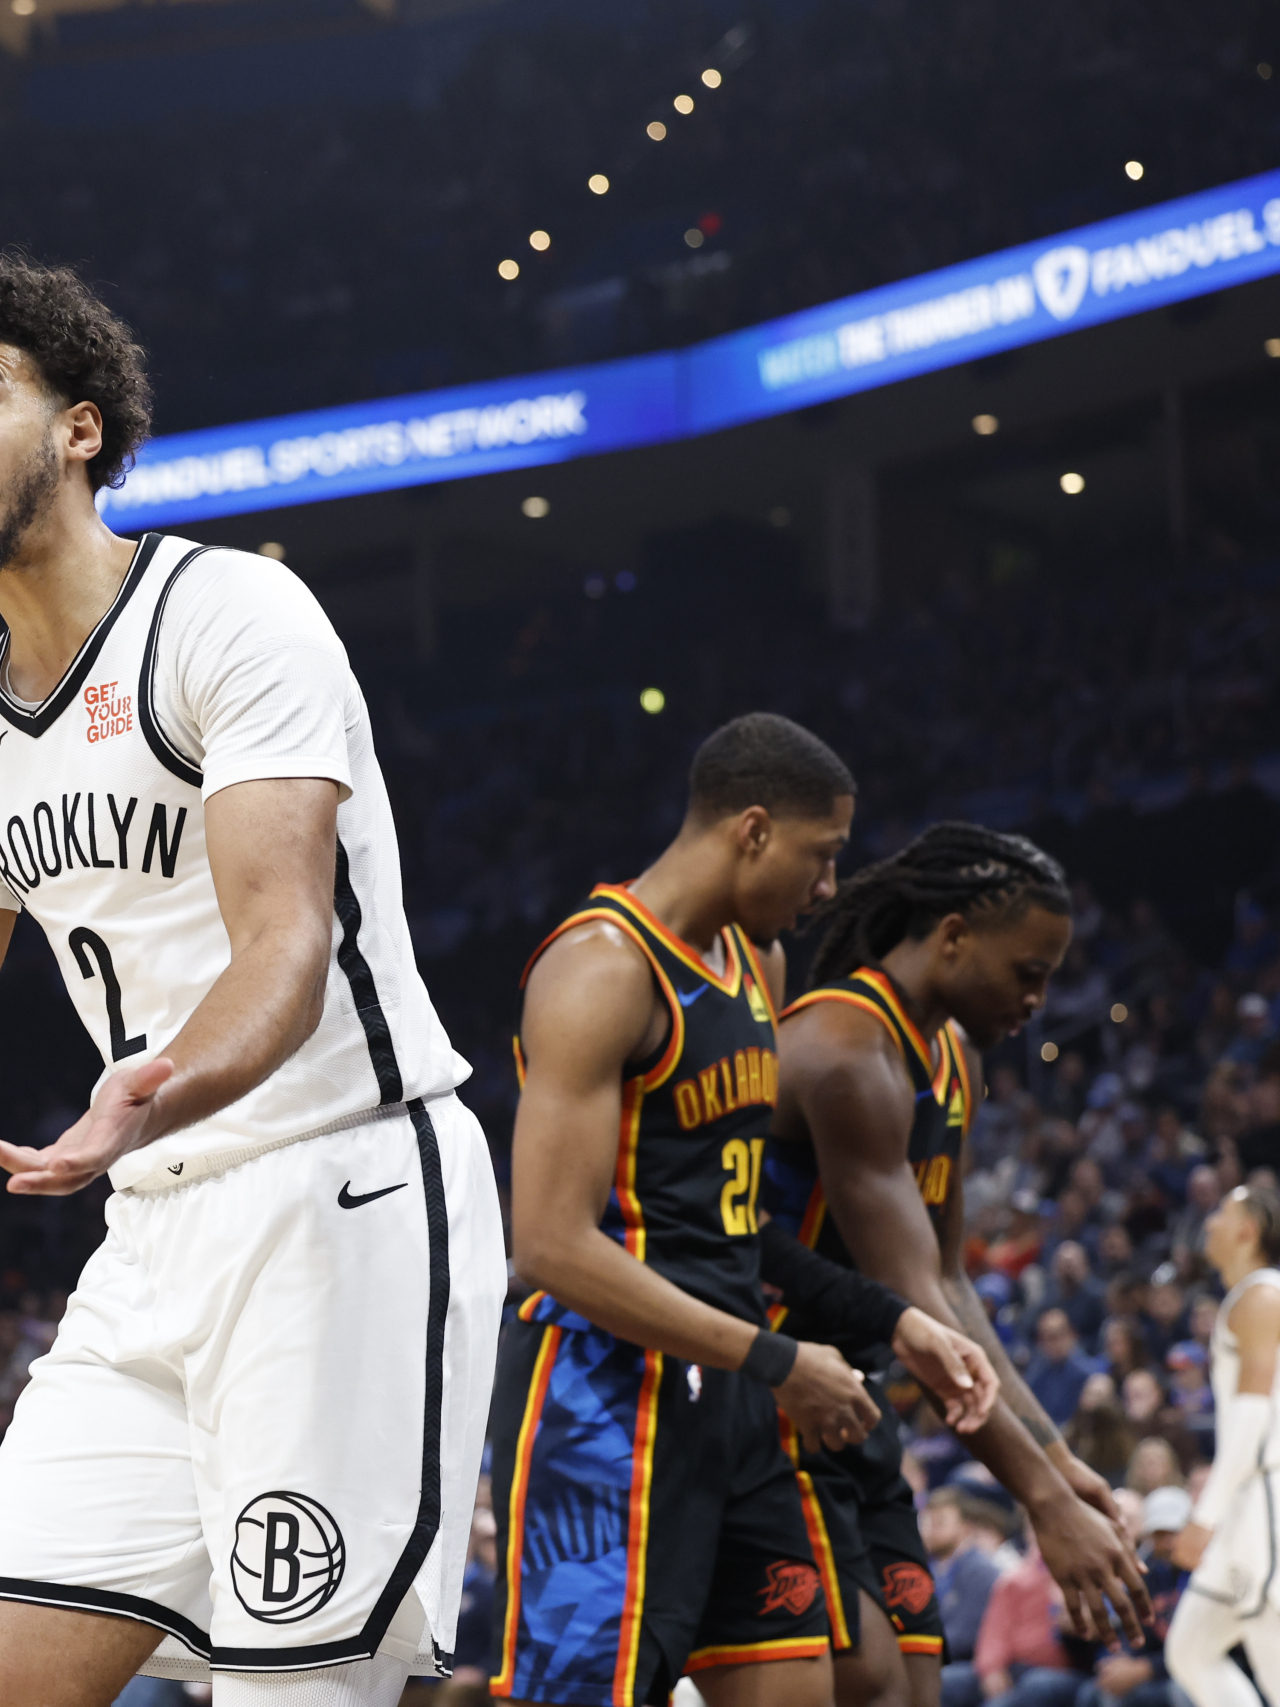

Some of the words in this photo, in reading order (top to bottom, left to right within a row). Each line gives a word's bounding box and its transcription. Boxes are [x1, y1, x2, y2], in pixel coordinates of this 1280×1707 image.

[1091, 207, 1267, 298] FANDUEL
[268, 420, 409, 483] SPORTS
[406, 389, 588, 457] NETWORK
[84, 681, 118, 705] GET
[85, 695, 132, 724] YOUR
[87, 713, 133, 743] GUIDE
[68, 926, 148, 1063] 2
[672, 1046, 779, 1131] OKLAHO
[721, 1137, 764, 1236] 21
[262, 1511, 301, 1603] B
